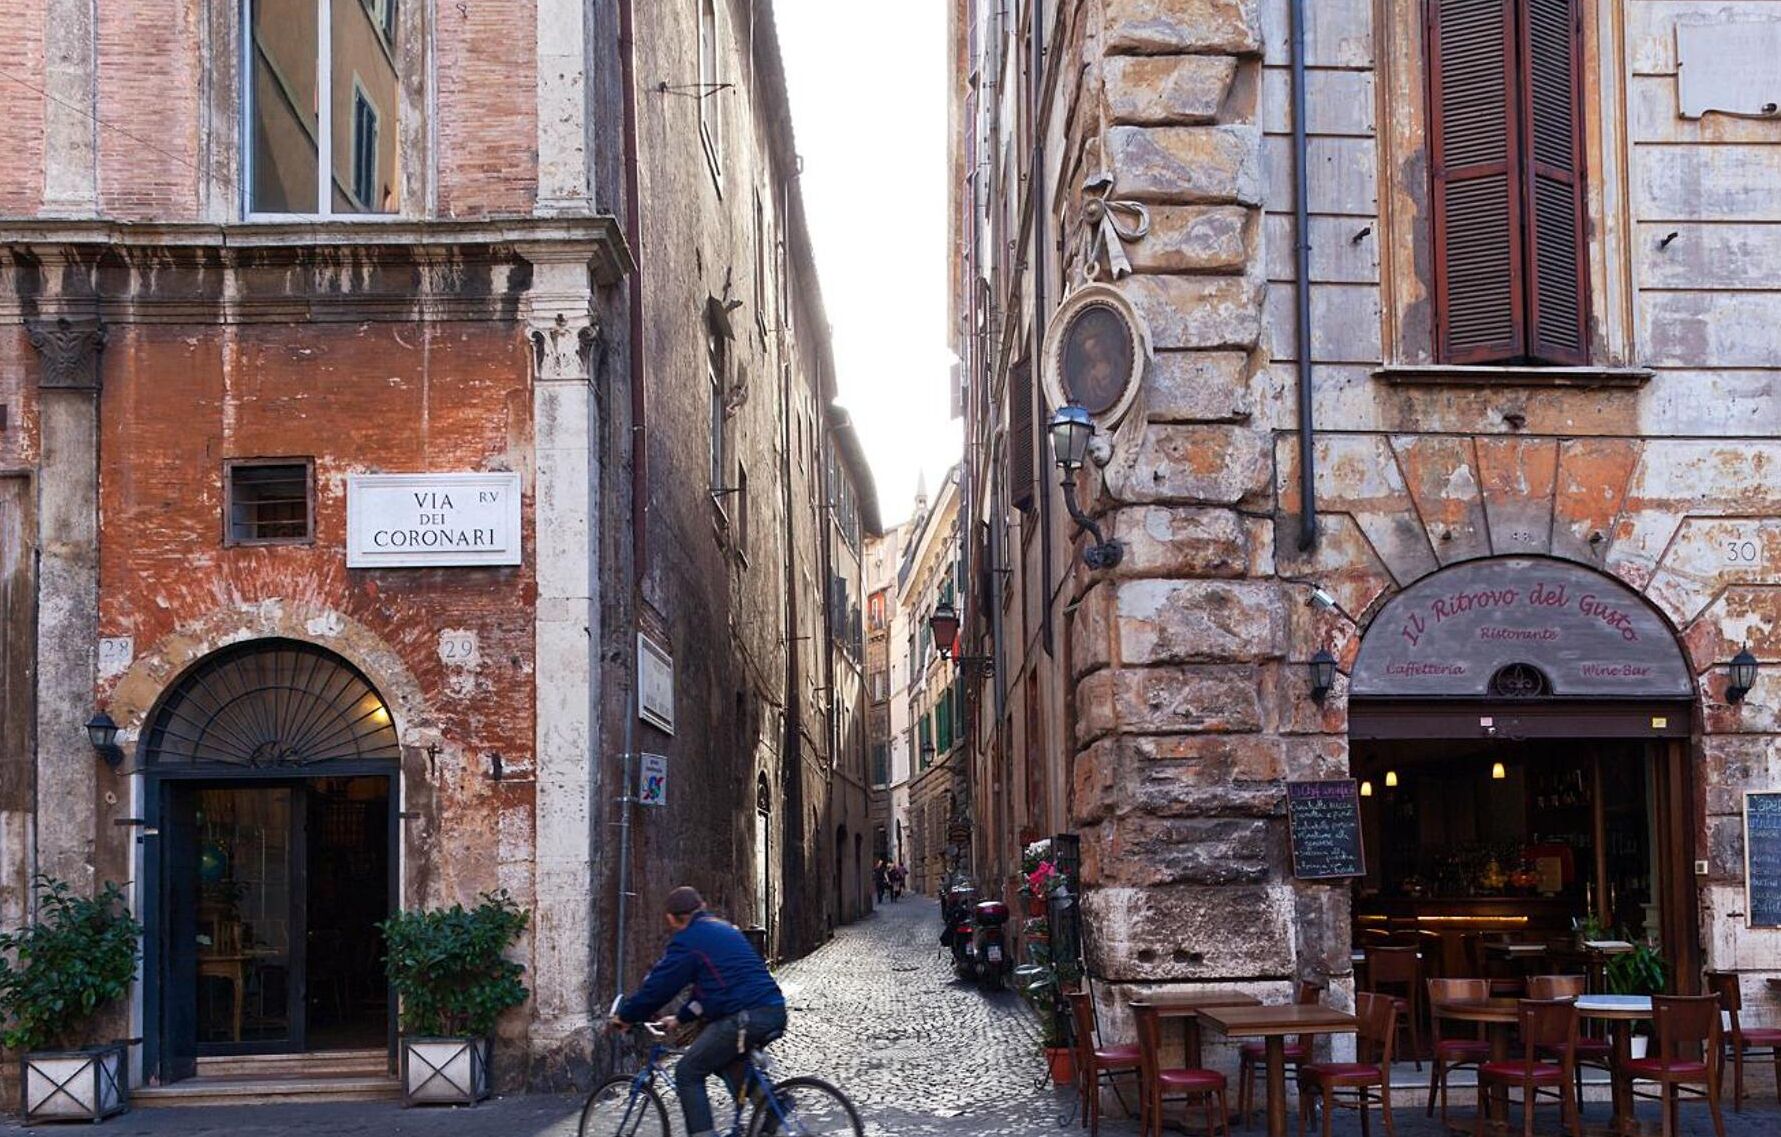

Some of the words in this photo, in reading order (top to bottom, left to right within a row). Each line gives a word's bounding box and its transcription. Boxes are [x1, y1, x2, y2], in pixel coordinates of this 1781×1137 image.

[414, 492, 454, 510] VIA
[419, 513, 445, 526] DEI
[374, 528, 494, 547] CORONARI
[1727, 541, 1756, 561] 30
[1402, 612, 1425, 647] Il
[1431, 589, 1519, 622] Ritrovo
[1529, 582, 1569, 607] del
[1579, 594, 1638, 641] Gusto
[1480, 626, 1559, 641] Ristorante
[104, 640, 129, 658] 28
[445, 639, 473, 658] 29
[1386, 661, 1466, 677] Caffetteria
